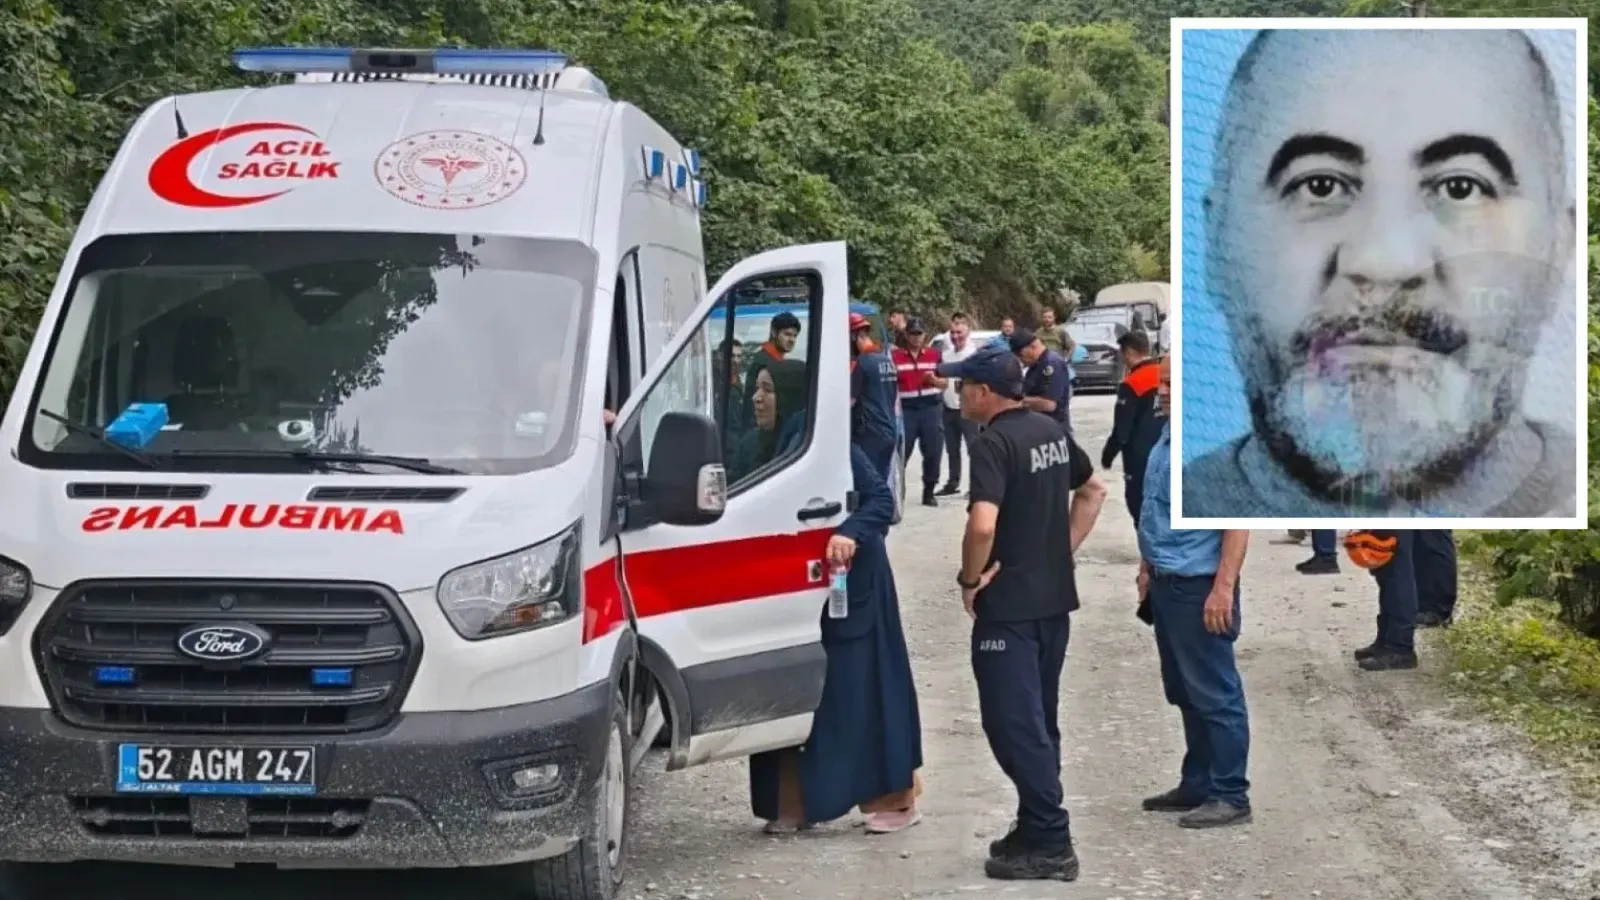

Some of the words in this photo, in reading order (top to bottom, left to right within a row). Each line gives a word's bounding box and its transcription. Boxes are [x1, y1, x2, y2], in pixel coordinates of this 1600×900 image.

[217, 158, 340, 179] SAĞLIK
[1030, 436, 1070, 473] AFAD
[194, 630, 247, 653] Ford
[980, 639, 1006, 651] AFAD
[138, 748, 173, 780] 52
[187, 748, 244, 781] AGM
[256, 749, 310, 782] 247
